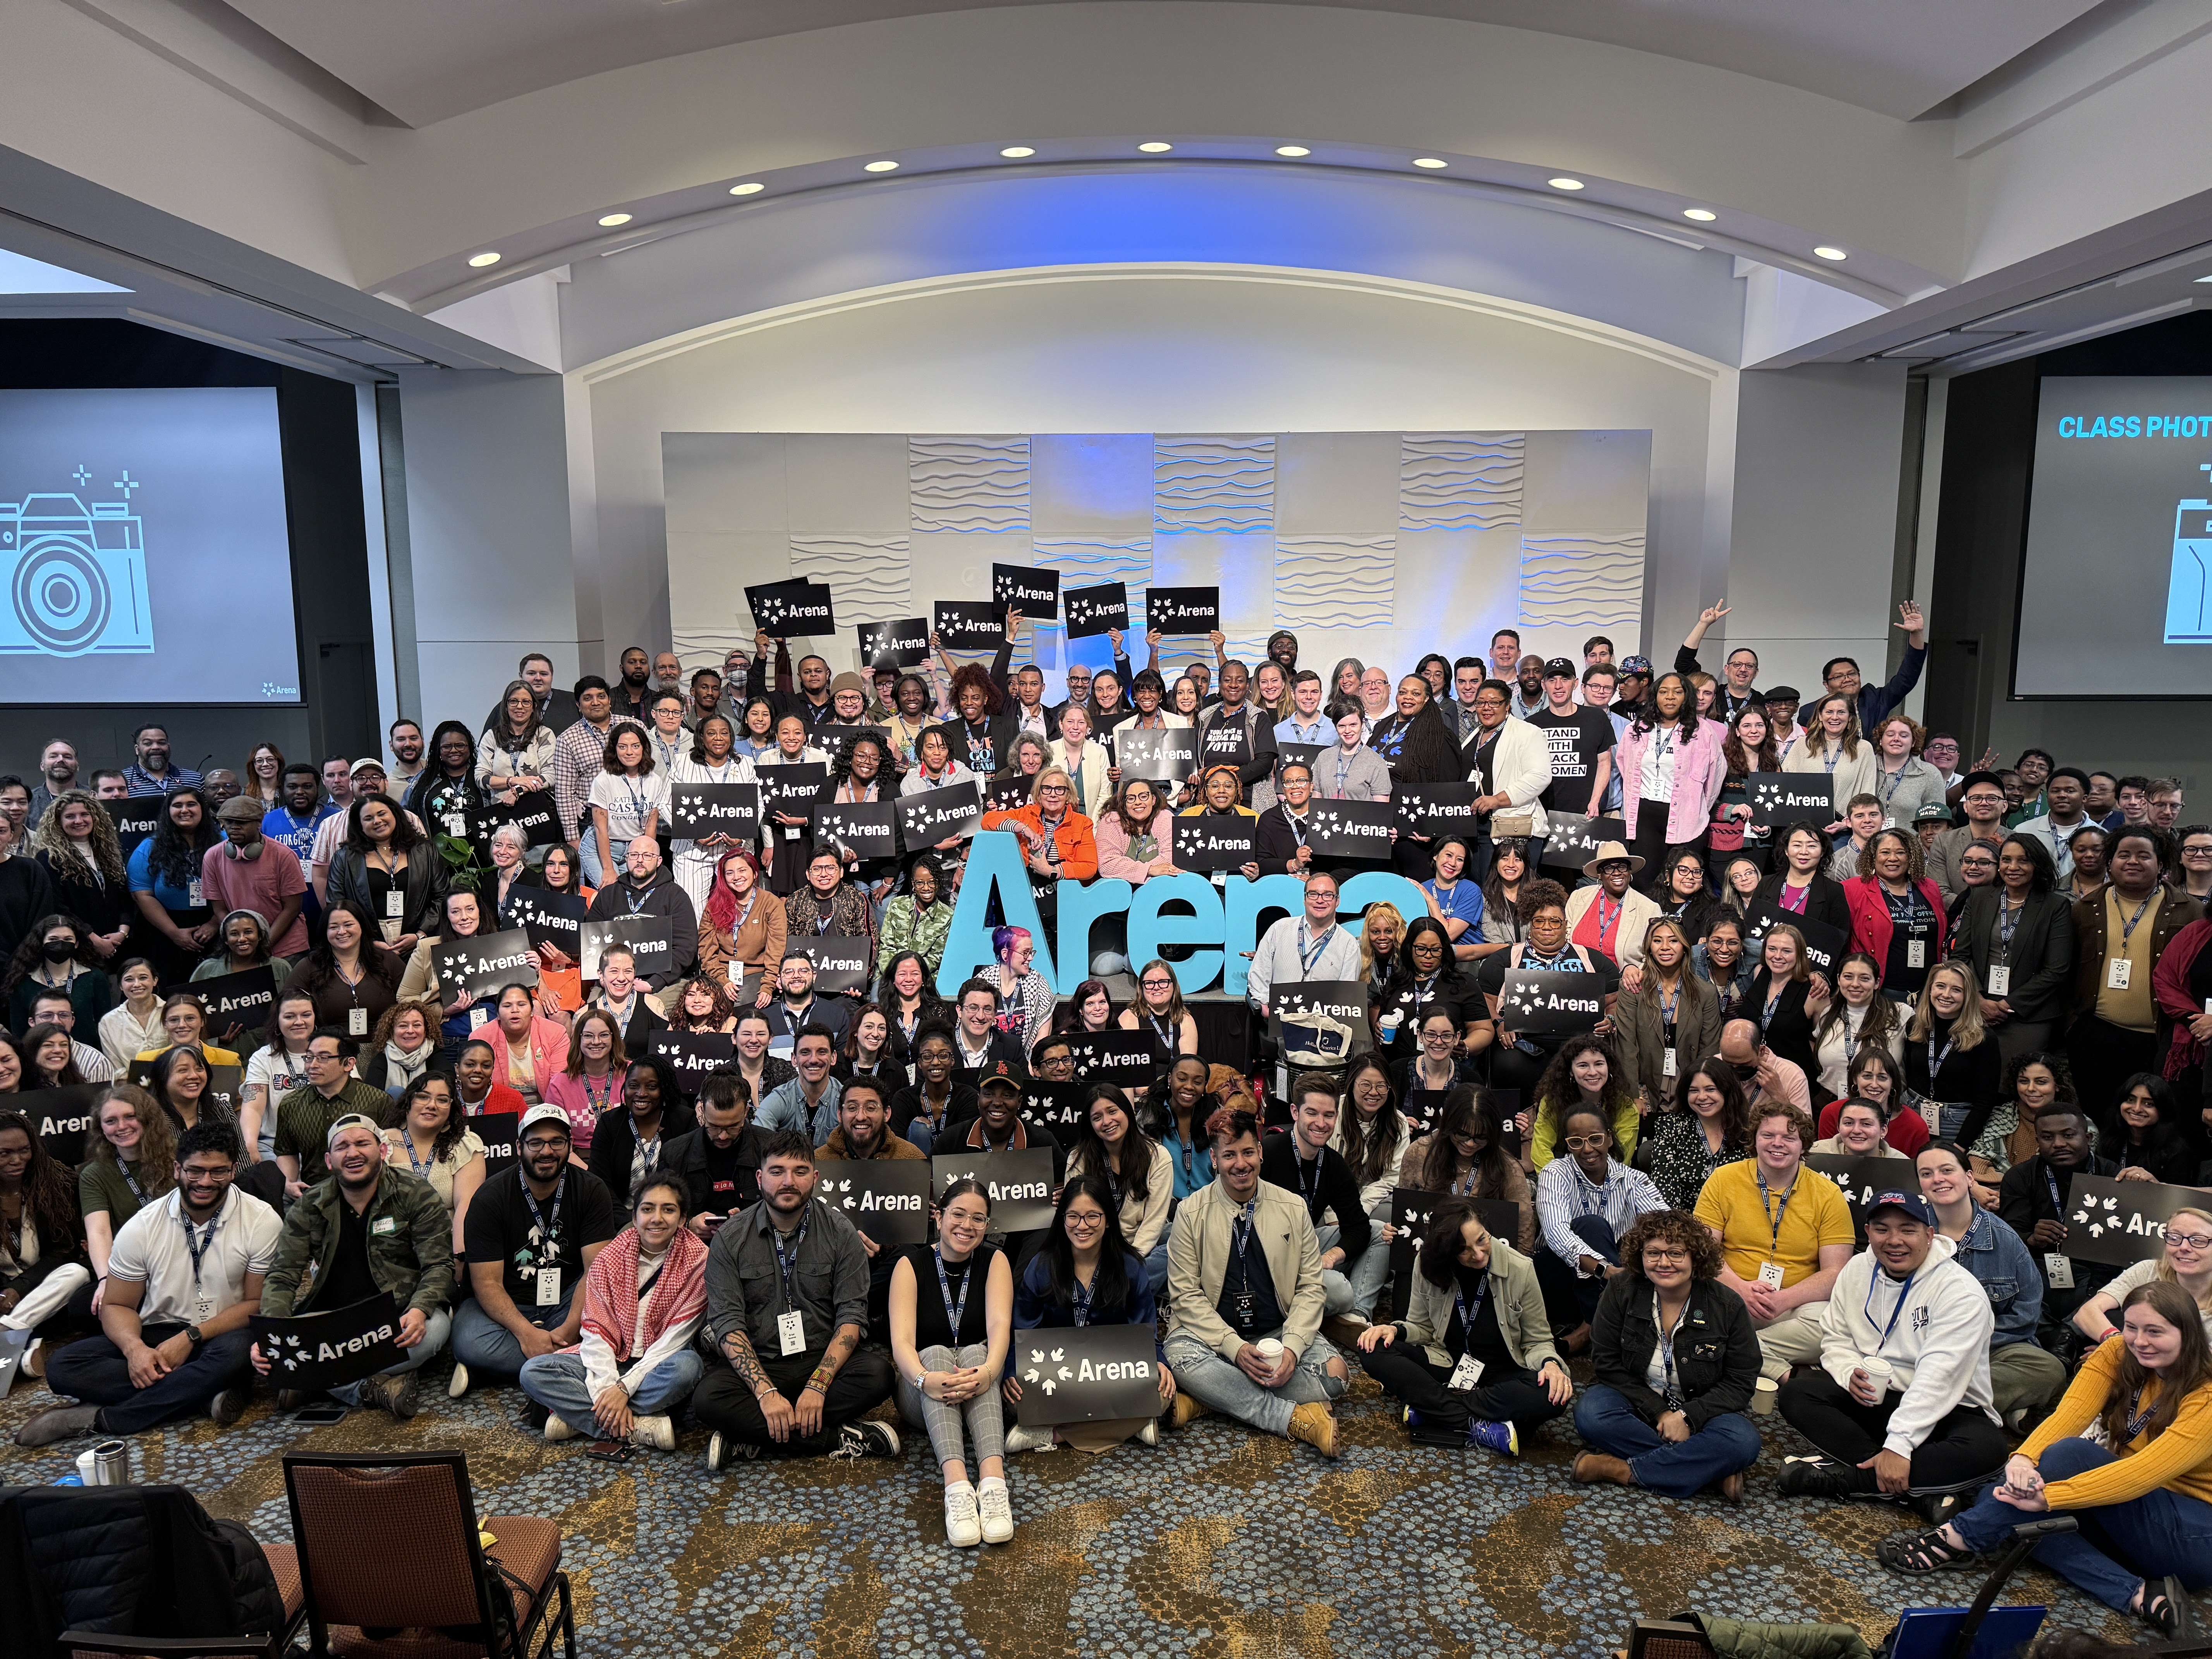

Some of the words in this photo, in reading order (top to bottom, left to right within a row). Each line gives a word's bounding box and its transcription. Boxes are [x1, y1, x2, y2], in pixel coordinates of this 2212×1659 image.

[2059, 416, 2141, 438] CLASS
[1016, 585, 1054, 601] Arena
[789, 605, 828, 618] Arena
[1096, 603, 1125, 617] Arena
[1177, 605, 1214, 617] Arena
[965, 619, 1002, 632] Arena
[891, 638, 926, 650] Arena
[276, 686, 296, 694] Arena
[1543, 729, 1578, 738] TAND
[1153, 747, 1192, 760] Arena
[1207, 741, 1237, 752] VOTE
[1548, 742, 1570, 750] ITH
[1551, 754, 1577, 762] ACK
[1551, 766, 1586, 775] OMEN
[1786, 792, 1829, 807] Arena
[709, 803, 753, 817] Arena
[936, 804, 977, 823] Arena
[1428, 803, 1471, 817] Arena
[1918, 805, 1941, 813] HUMAN
[119, 818, 157, 833] Aren
[508, 812, 550, 828] Arena
[848, 822, 890, 836] Arena
[1343, 820, 1388, 837] Arena
[275, 833, 303, 845] GEORGI
[1207, 836, 1250, 850] Arena
[536, 910, 578, 931] Arena
[623, 940, 667, 954] Arena
[478, 953, 526, 974] Arena
[819, 956, 863, 971] Arena
[1806, 946, 1831, 967] ena
[220, 991, 272, 1013] Arena
[1311, 1001, 1362, 1017] Arena
[1547, 994, 1599, 1012] Arena
[1102, 1052, 1150, 1067] Arena
[40, 1116, 93, 1136] Aren
[483, 1143, 512, 1158] ena
[988, 1181, 1047, 1201] Arena
[860, 1190, 921, 1211] Arena
[2126, 1212, 2167, 1239] Are
[318, 1324, 393, 1362] Arena
[1078, 1358, 1149, 1382] Arena
